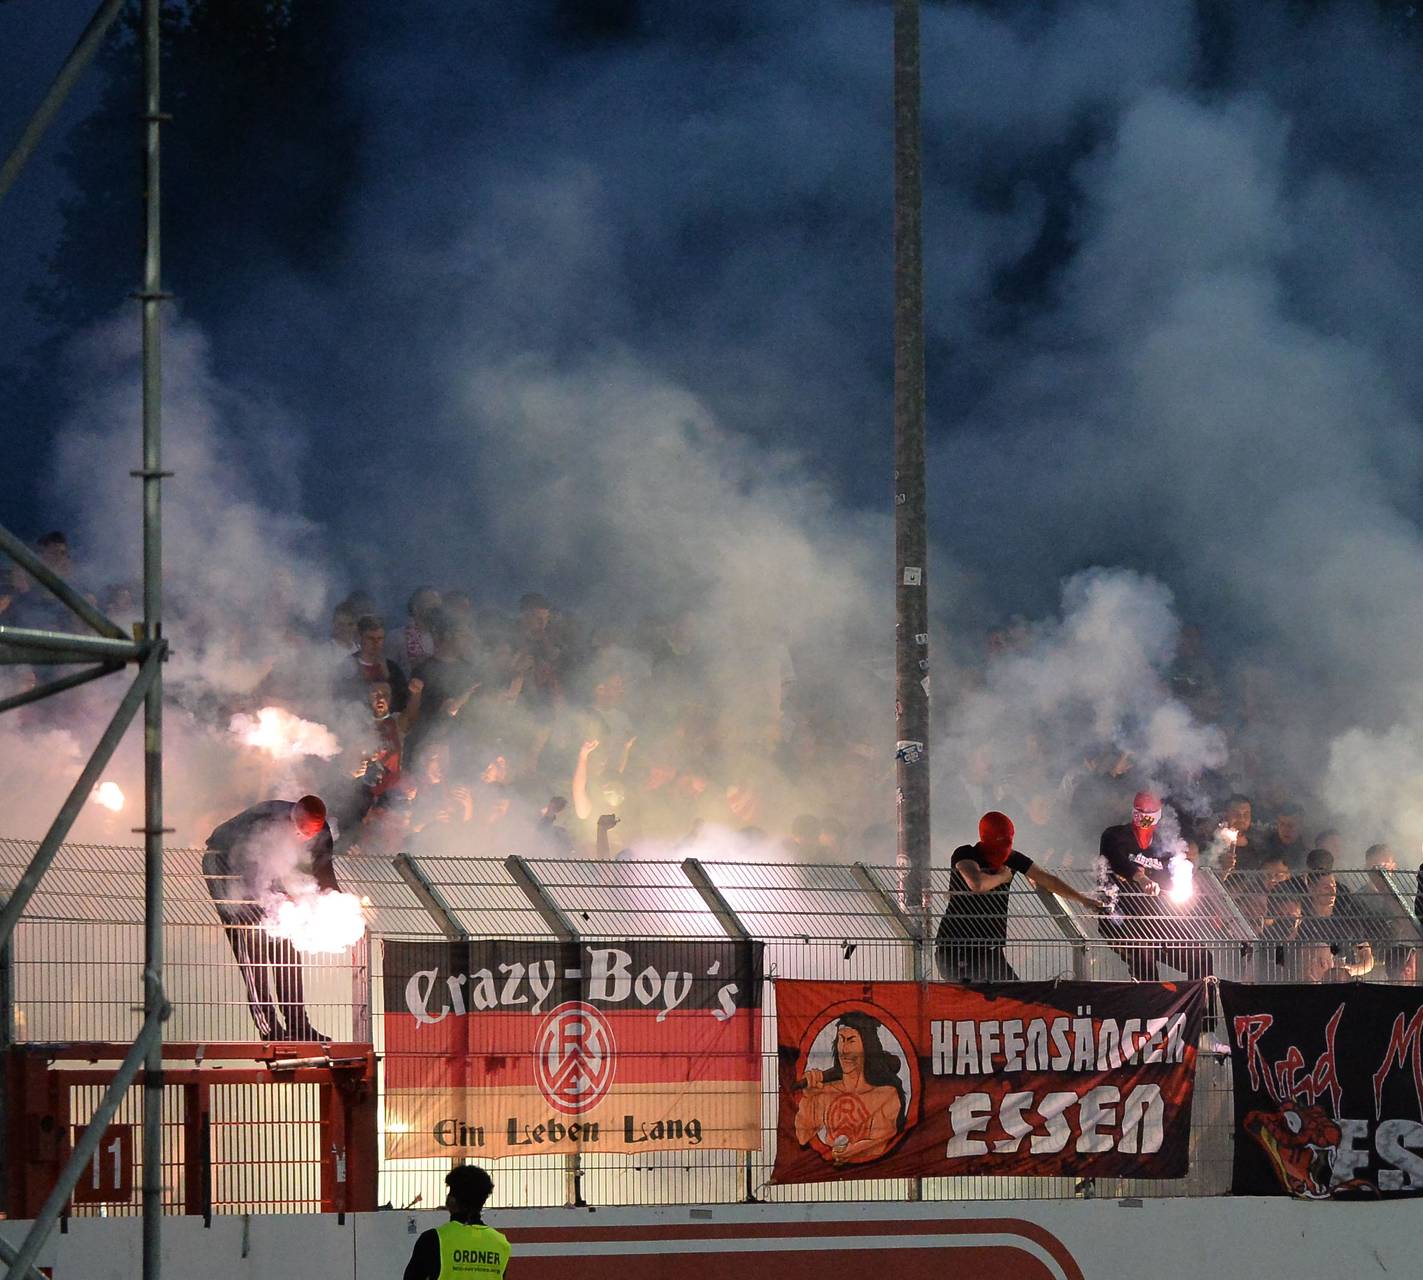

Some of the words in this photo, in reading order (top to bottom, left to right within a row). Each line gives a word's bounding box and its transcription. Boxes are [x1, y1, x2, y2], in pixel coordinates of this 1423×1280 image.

[433, 1117, 485, 1147] Ein
[507, 1117, 600, 1146] Leben
[624, 1115, 704, 1144] Lang
[946, 1083, 1165, 1158] ESSEN
[453, 1250, 501, 1265] ORDNER
